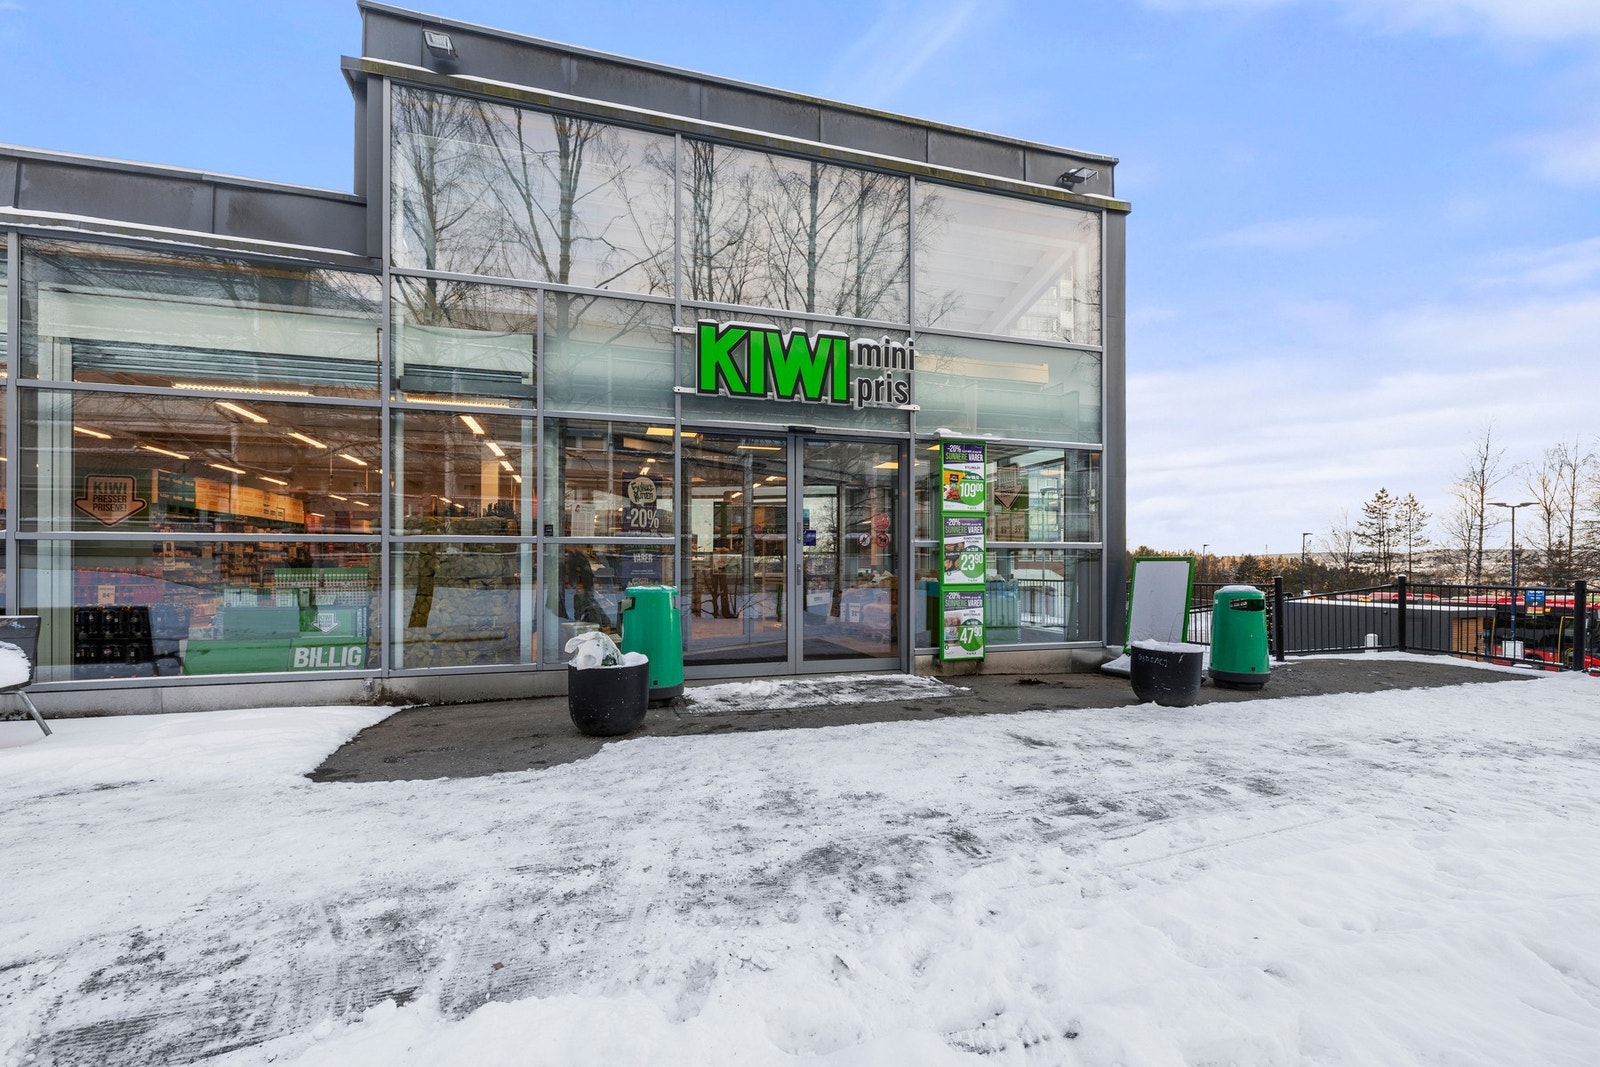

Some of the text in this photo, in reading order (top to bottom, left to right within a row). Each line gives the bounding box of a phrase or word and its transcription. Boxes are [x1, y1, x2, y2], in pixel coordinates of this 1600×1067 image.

[857, 338, 915, 370] mini
[697, 322, 850, 403] KIWI
[857, 371, 910, 408] pris
[968, 453, 983, 461] VARER
[93, 481, 127, 494] KIWI
[93, 495, 127, 503] PRESSER
[93, 503, 127, 512] PRISENE!
[626, 508, 660, 529] -20%
[968, 526, 983, 534] VARER
[633, 553, 653, 564] VARER
[293, 646, 362, 668] BILLIG
